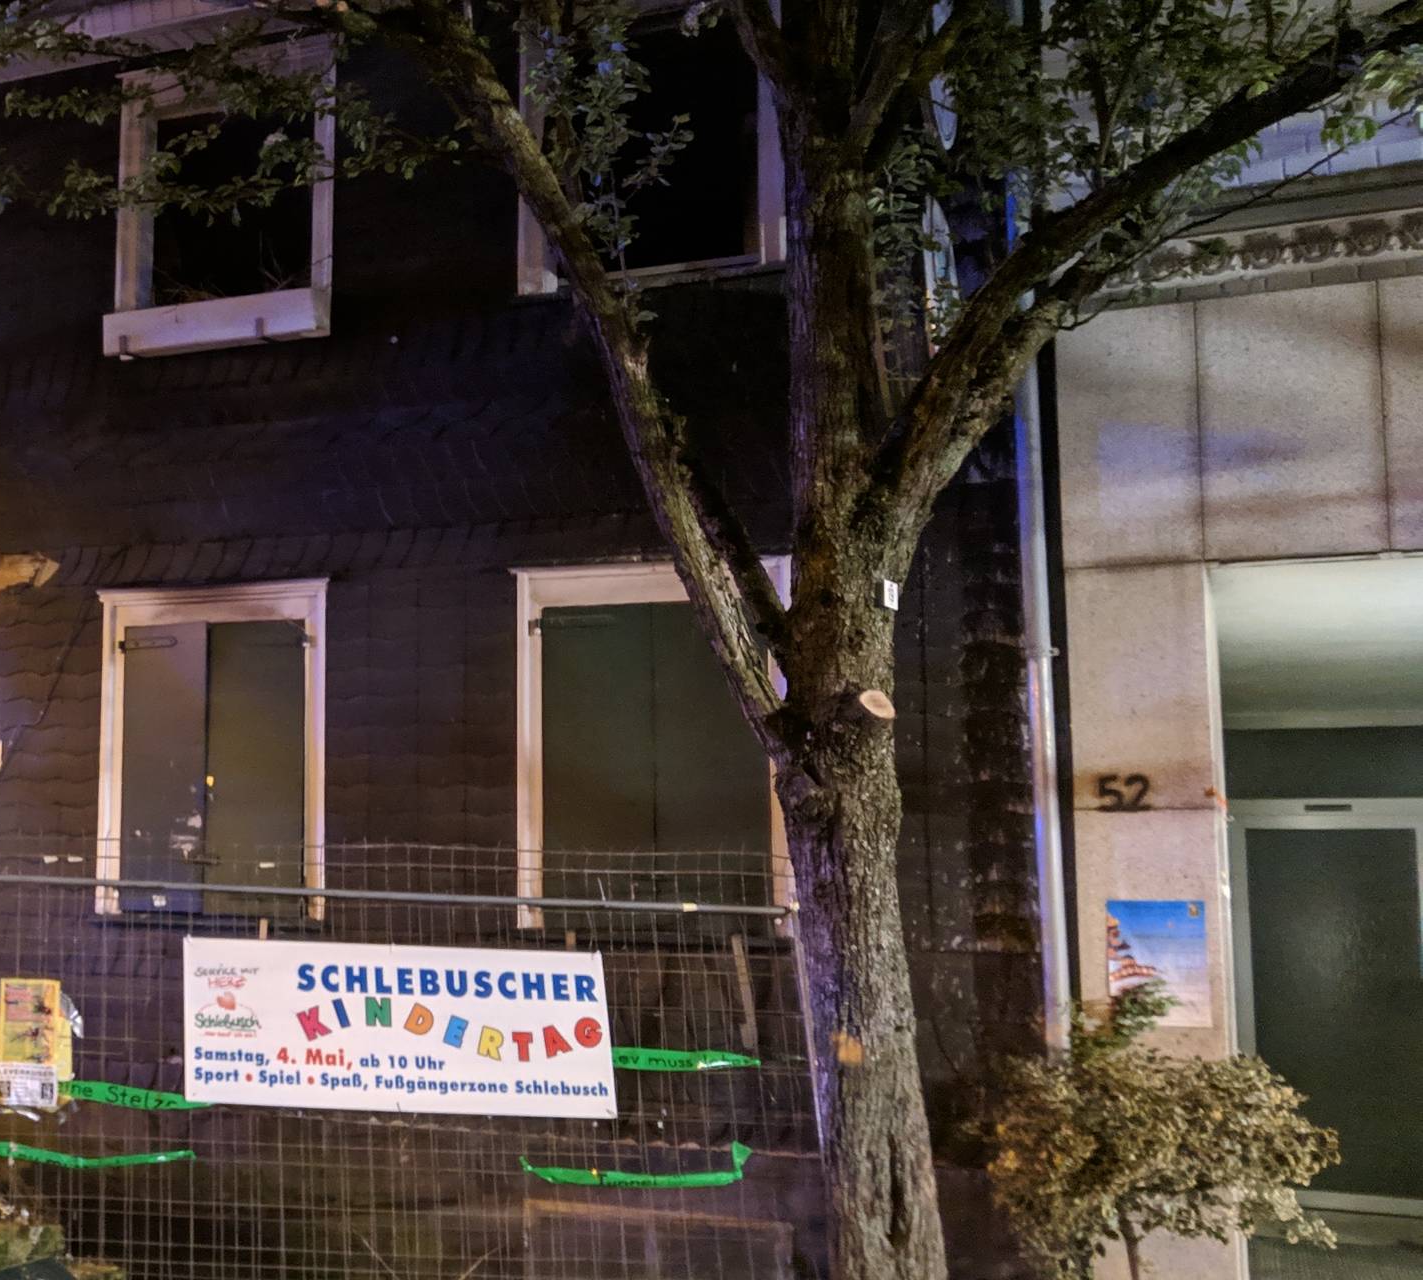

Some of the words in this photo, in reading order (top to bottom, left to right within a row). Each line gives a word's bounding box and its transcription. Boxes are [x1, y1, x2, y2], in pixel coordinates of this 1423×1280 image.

[1097, 773, 1150, 810] 52
[297, 963, 598, 1002] SCHLEBUSCHER
[296, 997, 603, 1062] KINDERTAG
[194, 1047, 270, 1066] Samstag,
[277, 1048, 296, 1064] 4.
[305, 1048, 353, 1071] Mai,
[359, 1054, 380, 1068] ab
[388, 1055, 408, 1069] 10
[415, 1056, 446, 1071] Uhr
[648, 1057, 694, 1069] muss
[194, 1067, 239, 1087] Sport
[258, 1070, 301, 1089] Spiel
[320, 1072, 368, 1091] Spaß,
[375, 1075, 509, 1095] Fußgängerzone
[515, 1080, 609, 1097] Schlebusch
